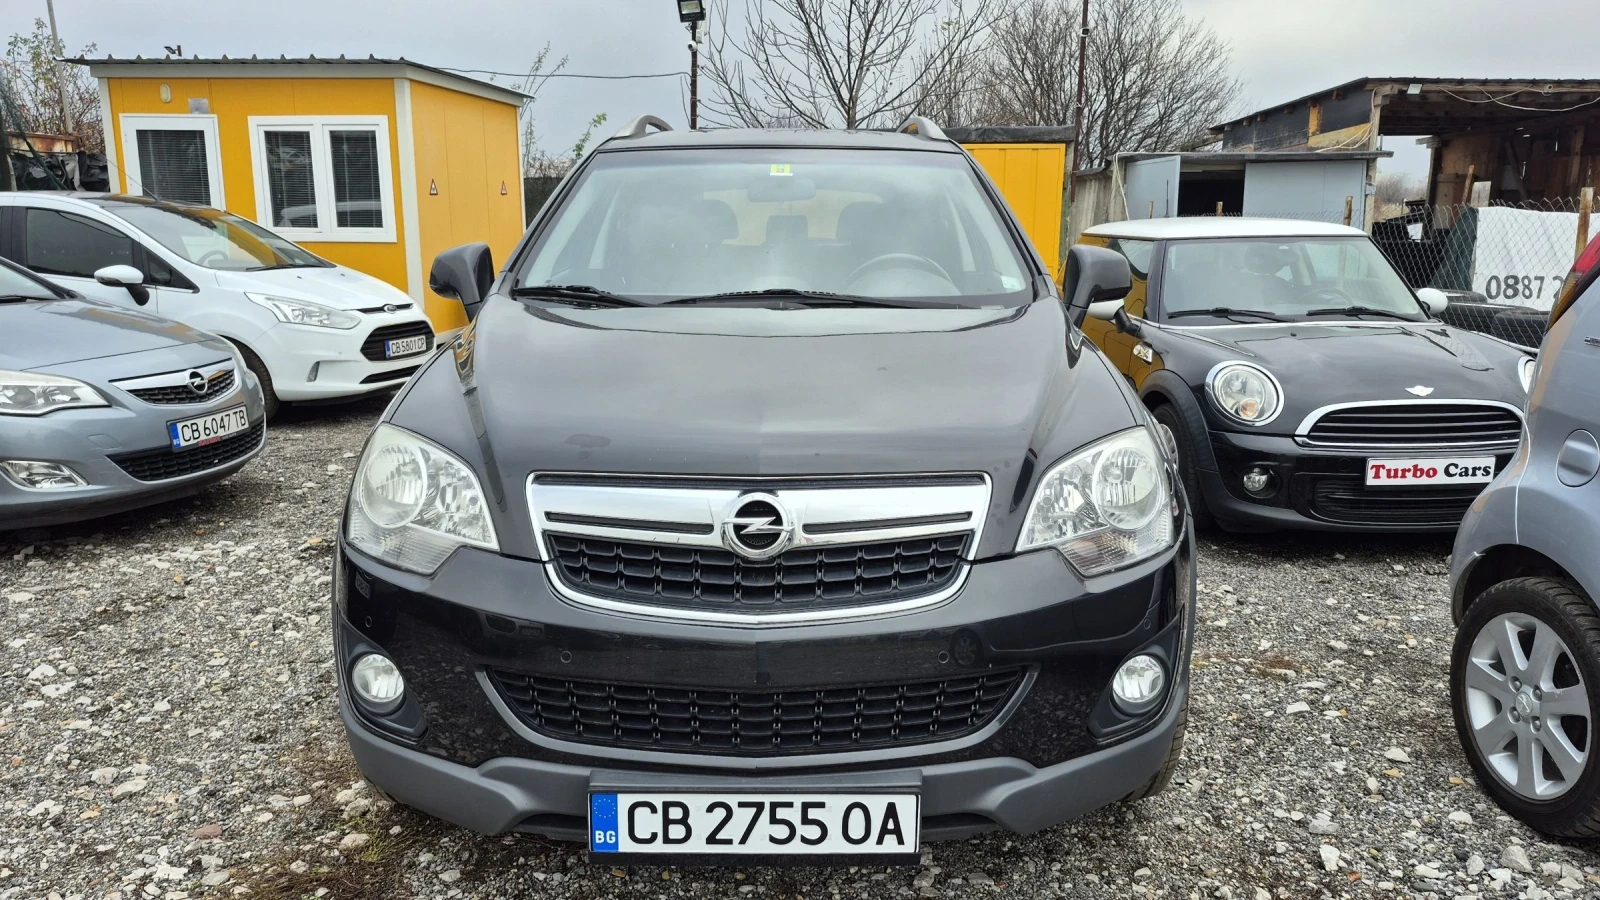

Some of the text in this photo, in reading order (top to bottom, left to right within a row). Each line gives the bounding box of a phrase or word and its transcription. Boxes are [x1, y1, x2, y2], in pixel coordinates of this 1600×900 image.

[1485, 274, 1545, 299] 0887
[181, 422, 201, 443] CB
[203, 413, 231, 437] 6047
[232, 409, 246, 428] TB
[1370, 462, 1491, 480] Turbo Cars
[627, 800, 905, 846] CB 2755 OA
[595, 830, 616, 844] BG
